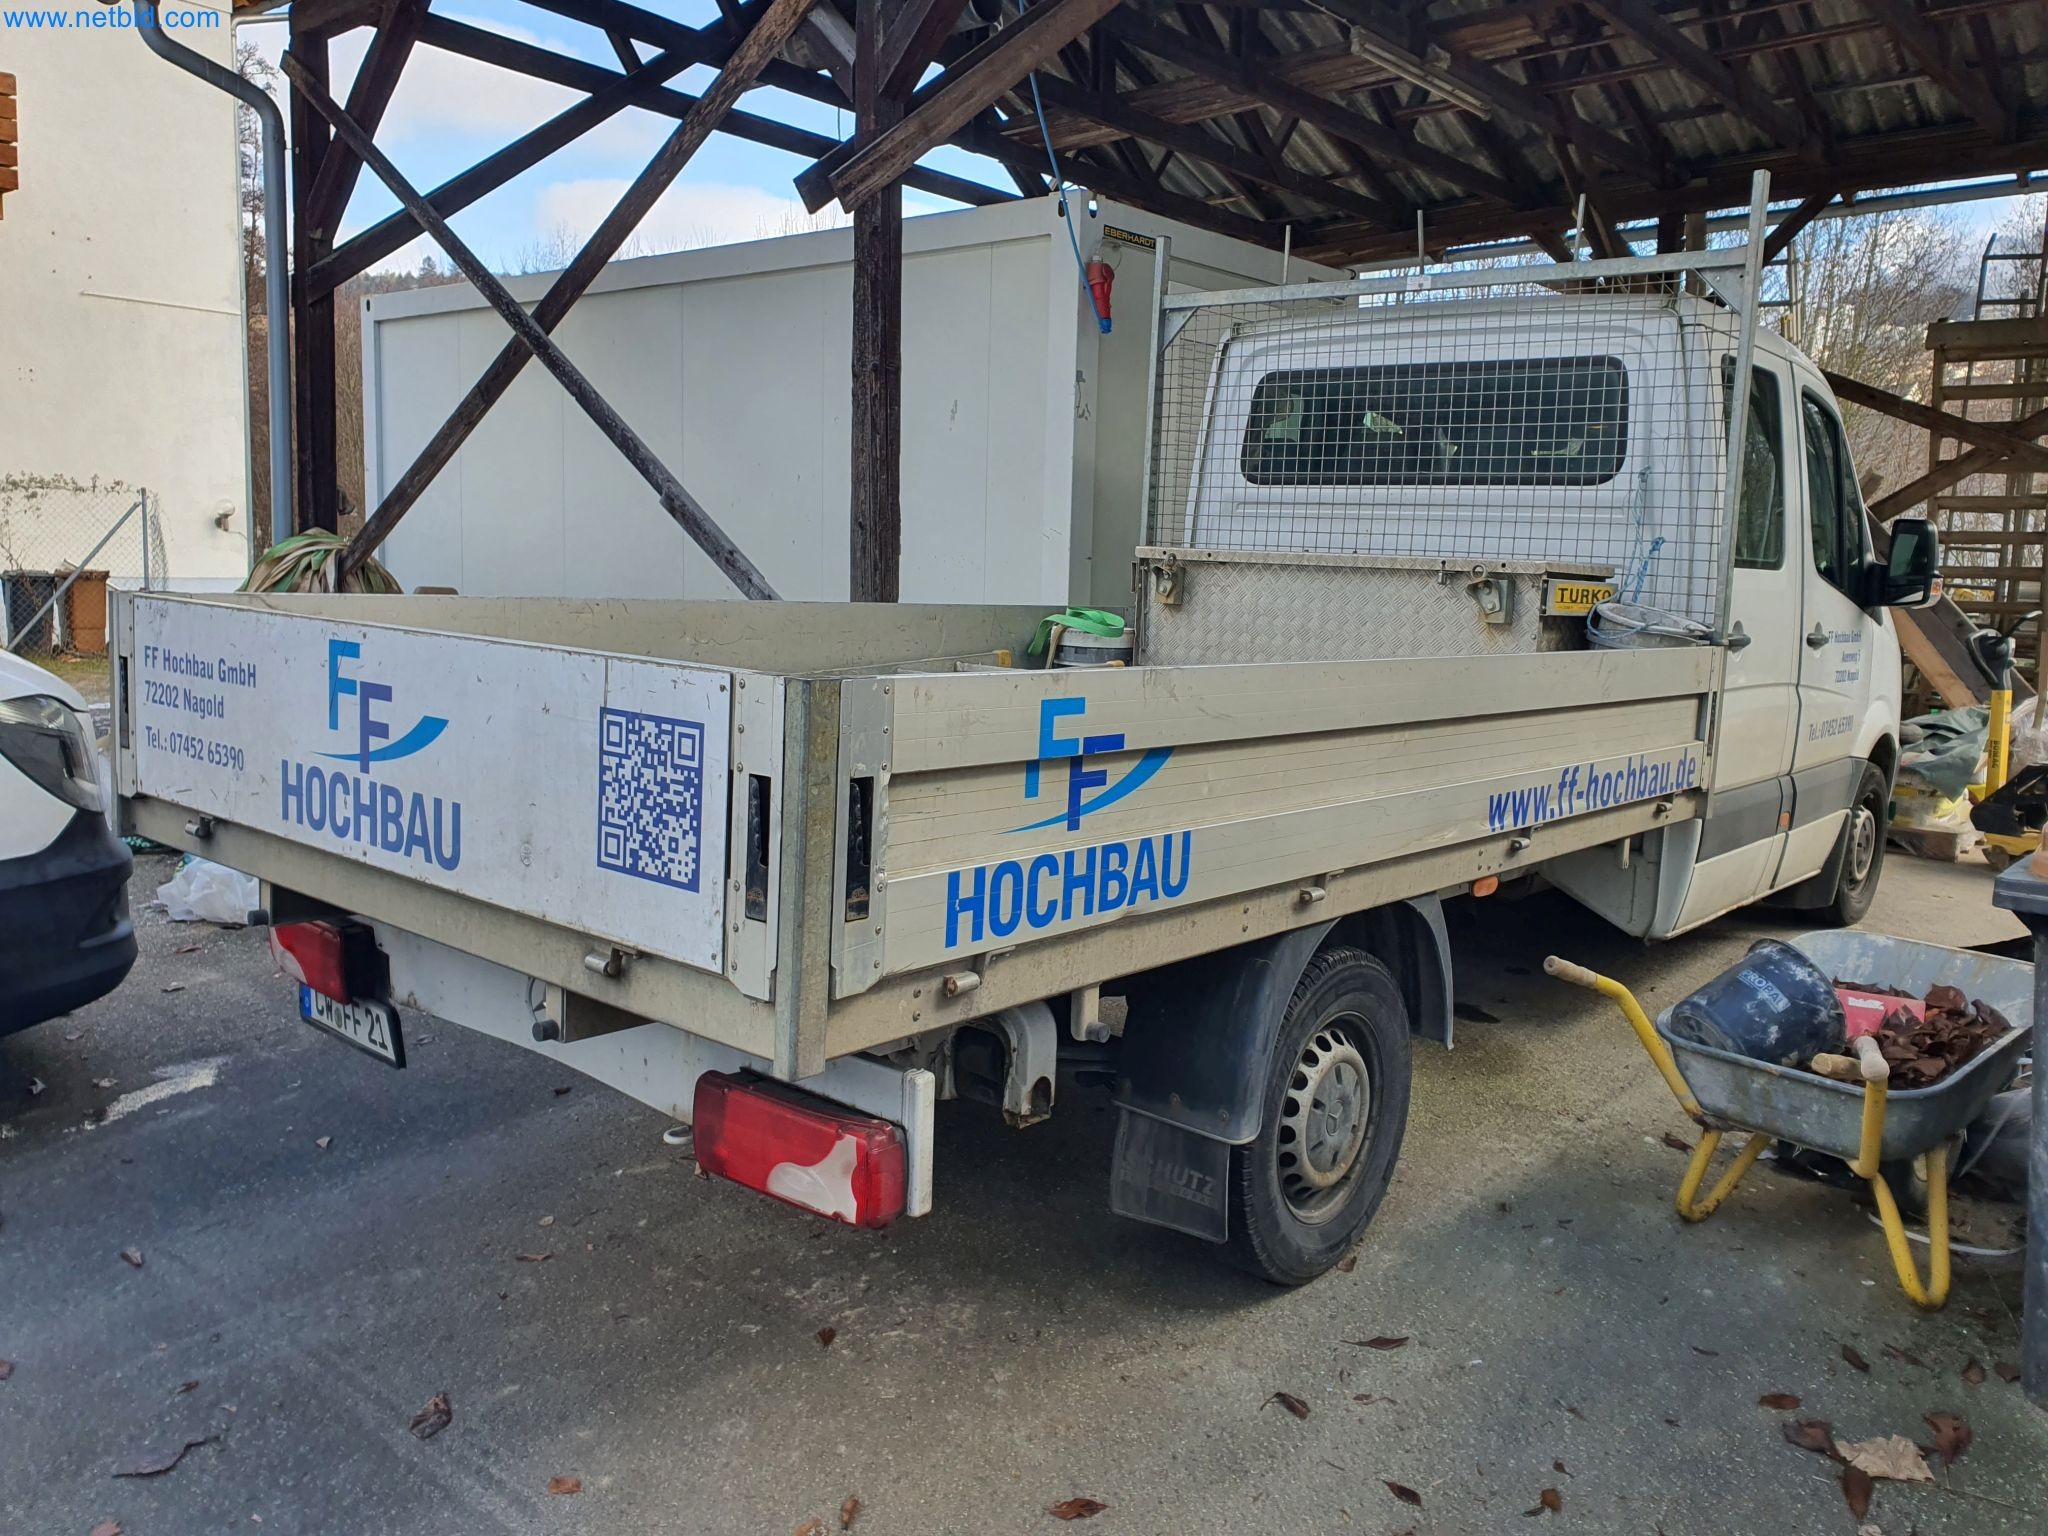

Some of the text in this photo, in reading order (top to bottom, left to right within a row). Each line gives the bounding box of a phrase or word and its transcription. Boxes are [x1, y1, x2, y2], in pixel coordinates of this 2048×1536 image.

[1104, 227, 1155, 248] EBERHARDT
[144, 645, 257, 689] FF Hochbau GmbH
[144, 679, 225, 720] 72202 Nagold
[329, 639, 393, 775] FF
[207, 740, 245, 772] 65390
[1488, 747, 1697, 833] www.ff-hochbau.de
[281, 758, 462, 872] HOCHBAU
[944, 829, 1193, 949] HOCHBAU
[364, 1006, 389, 1052] 21
